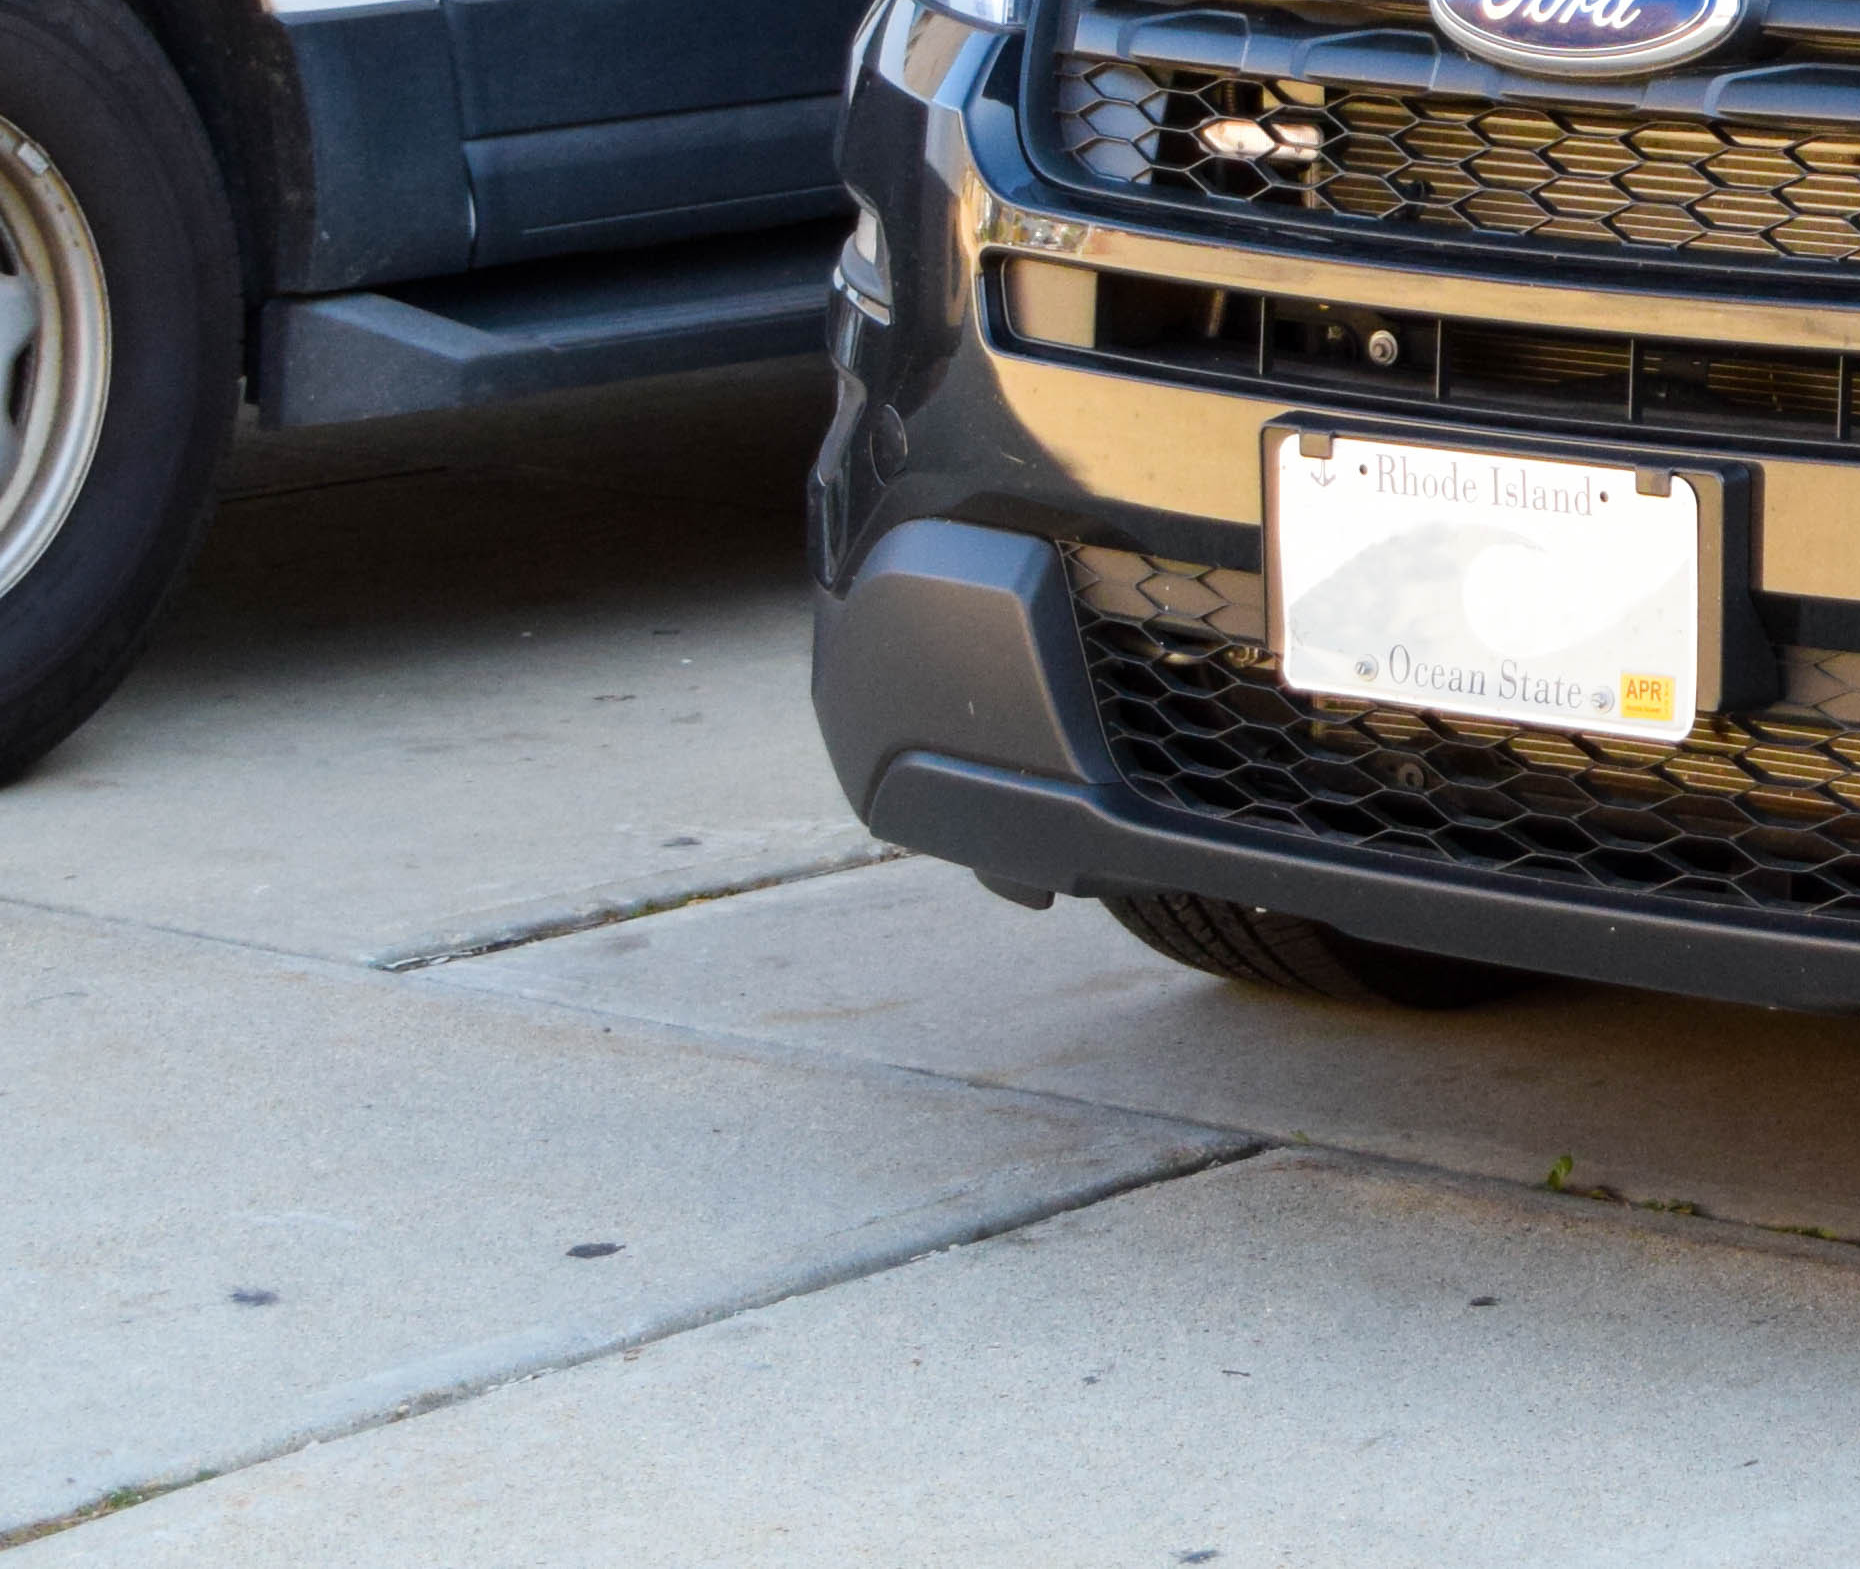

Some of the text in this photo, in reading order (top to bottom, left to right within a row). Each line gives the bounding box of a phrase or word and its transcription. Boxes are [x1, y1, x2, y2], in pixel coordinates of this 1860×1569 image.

[1375, 453, 1593, 517] Rhode Island
[1389, 643, 1584, 709] Ocean State
[1626, 678, 1662, 703] APR
